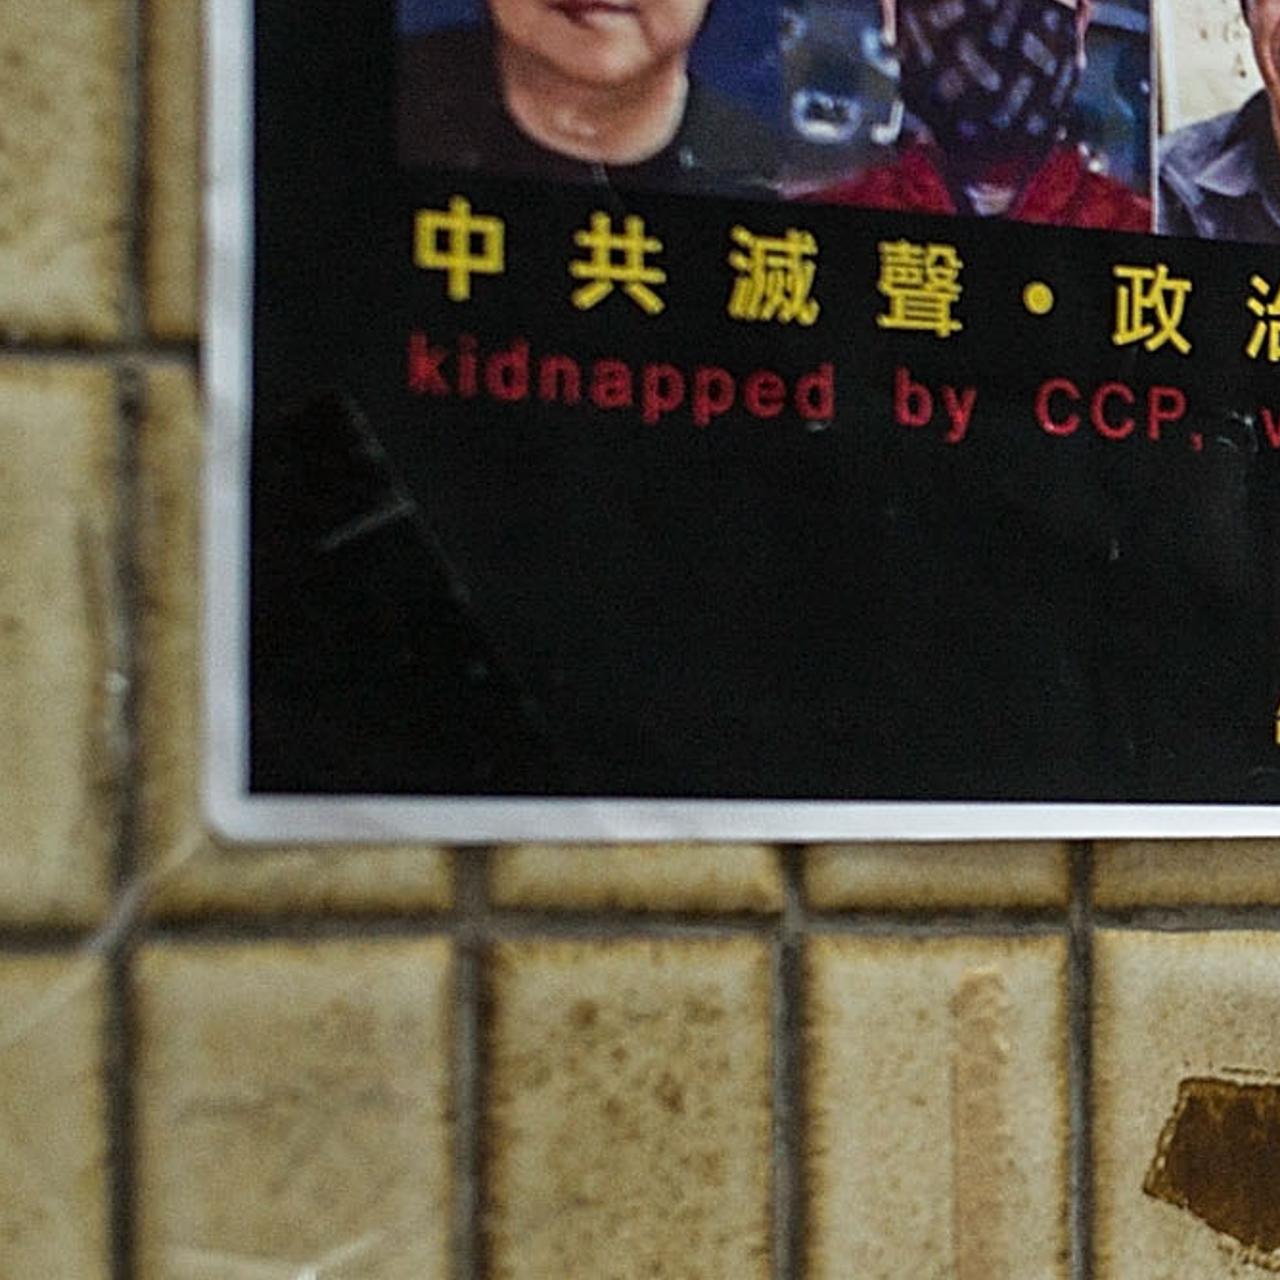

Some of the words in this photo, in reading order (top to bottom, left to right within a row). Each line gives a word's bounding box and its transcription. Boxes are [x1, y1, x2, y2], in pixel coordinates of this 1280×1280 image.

[407, 331, 836, 426] kidnapped
[893, 366, 979, 444] by
[1034, 377, 1204, 451] CCP,
